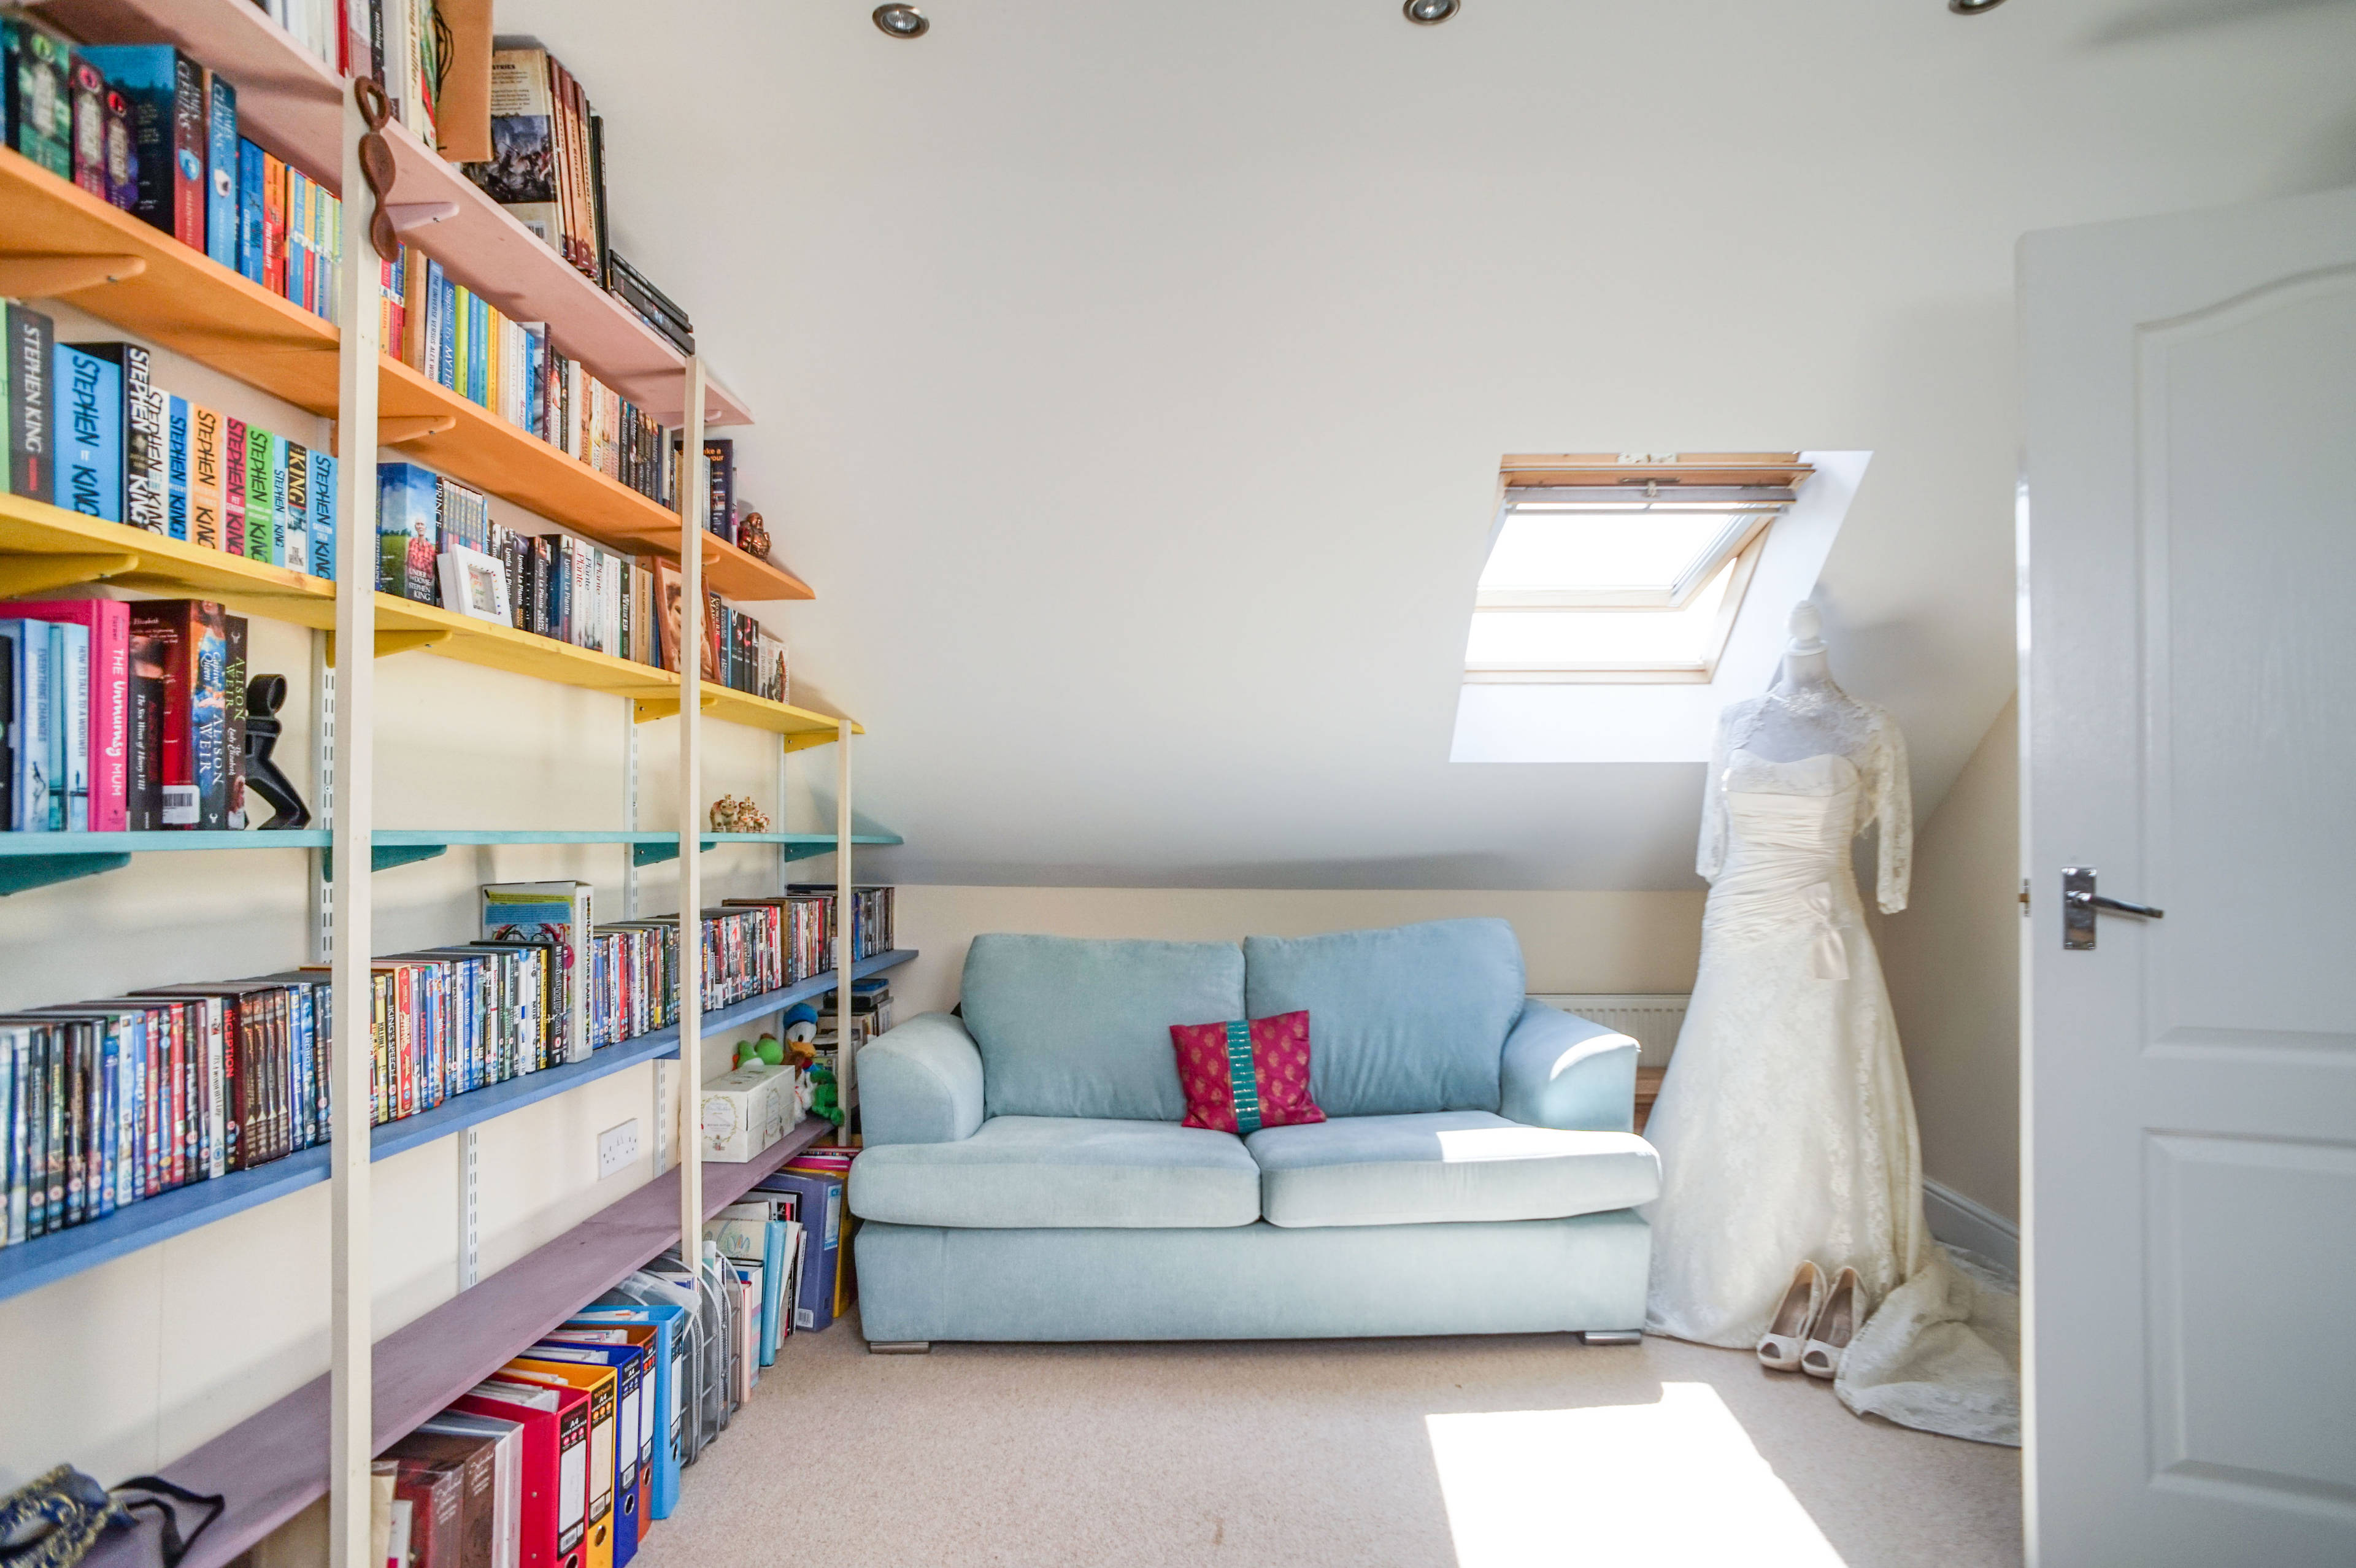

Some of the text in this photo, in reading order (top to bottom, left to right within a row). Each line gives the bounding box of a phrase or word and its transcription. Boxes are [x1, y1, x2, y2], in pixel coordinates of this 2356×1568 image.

[445, 286, 454, 325] Stephen
[24, 325, 40, 405] STEPHEN
[25, 406, 41, 453] KING
[72, 356, 100, 517] STEPHEN KING
[129, 348, 150, 524] STEPHEN KING
[148, 391, 163, 472] STEPHEN
[170, 415, 186, 534] STEPHEN KING
[196, 410, 215, 549] STEPHEN KING
[226, 419, 245, 556] STEPHEN KING
[250, 431, 268, 502] STEPHEN
[288, 451, 305, 504] KING
[275, 469, 285, 547] STEPHEN KING
[315, 455, 331, 579] STEPHEN KING
[250, 522, 268, 563] KING
[409, 567, 427, 578] UNDER
[409, 583, 431, 594] STEPHEN
[576, 553, 585, 587] Plante
[414, 590, 430, 602] KING
[78, 645, 87, 664] HOW
[78, 666, 87, 675] TO
[201, 653, 212, 681] Queen
[211, 651, 221, 685] Captive
[78, 678, 87, 696] TALK
[78, 700, 87, 709] TO
[226, 663, 234, 710] WEIR
[234, 657, 245, 721] ALISON
[105, 648, 126, 796] THE Unmumsy MUM
[136, 750, 145, 772] Henry
[199, 722, 212, 775] WEIR
[212, 713, 224, 786] ALISON
[227, 744, 237, 776] Elizabeth
[224, 1009, 234, 1077] INCEPTION
[187, 1063, 196, 1120] HULK
[599, 1393, 607, 1404] A4
[569, 1417, 579, 1429] A4
